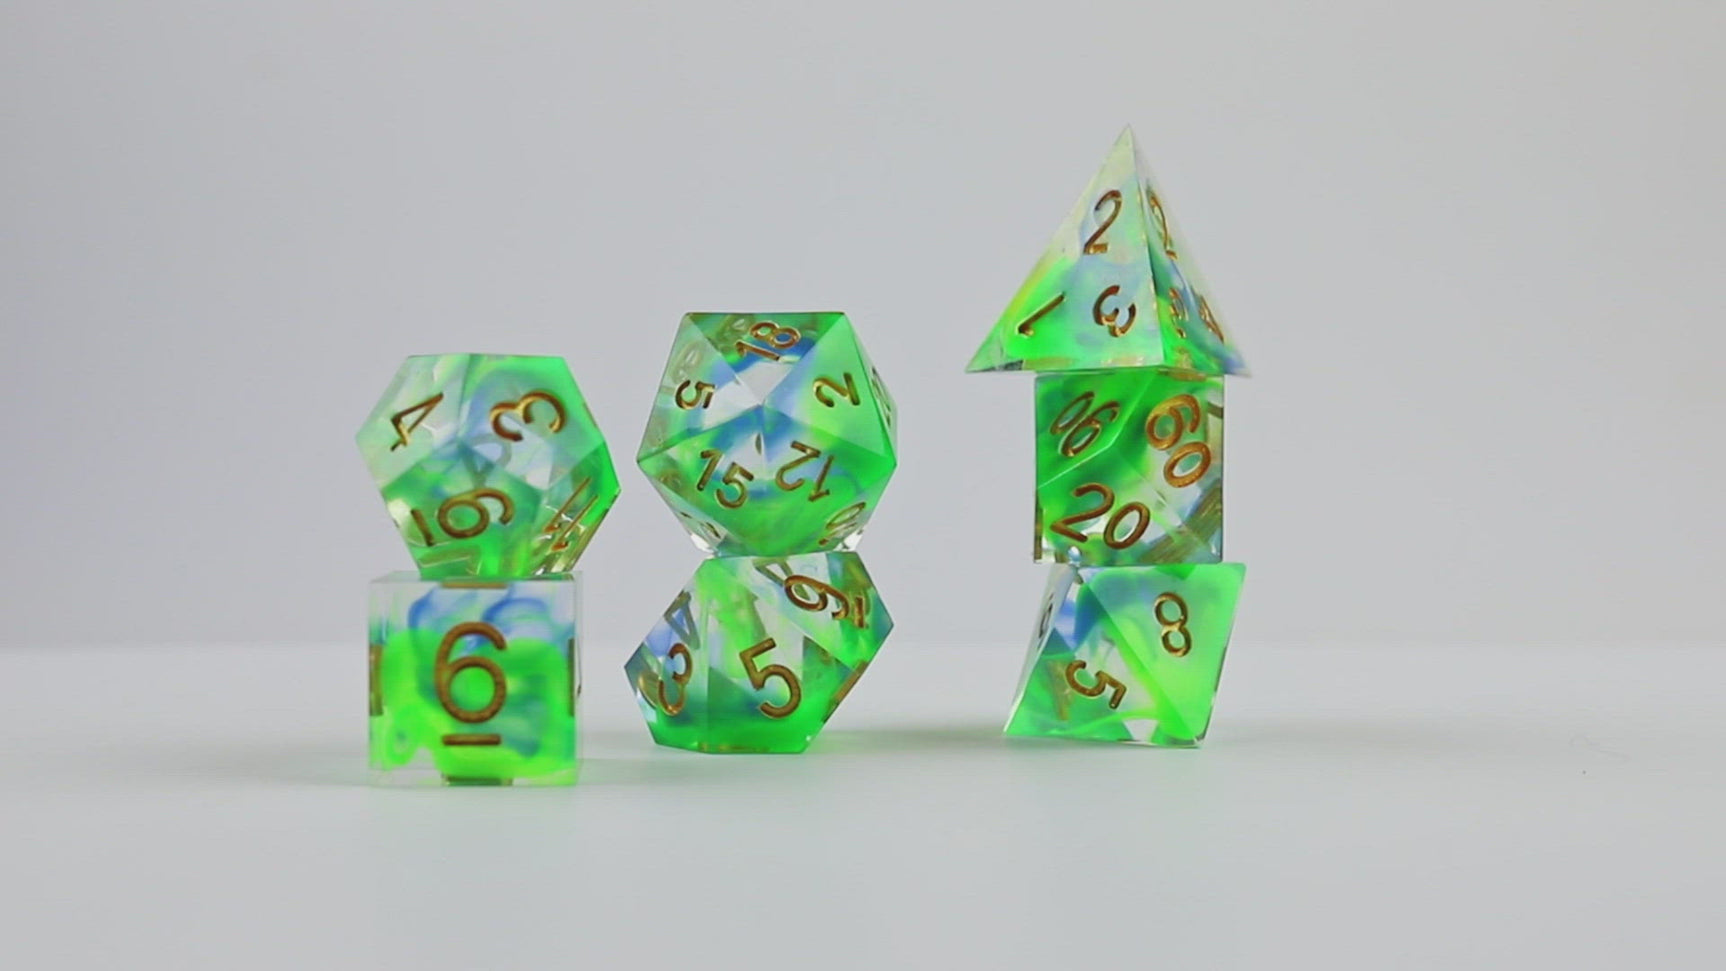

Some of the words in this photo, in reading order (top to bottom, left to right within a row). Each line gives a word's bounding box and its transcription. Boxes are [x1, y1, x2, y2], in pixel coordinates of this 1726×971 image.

[1084, 190, 1122, 255] 2
[1018, 292, 1065, 336] 1
[1093, 285, 1136, 337] 3
[735, 321, 801, 362] 18
[489, 388, 567, 442] 3
[675, 380, 715, 411] 5
[813, 372, 861, 408] 2
[390, 393, 444, 451] 4
[697, 449, 753, 509] 15
[1050, 483, 1151, 550] 20
[1154, 592, 1192, 657] 8
[433, 622, 508, 724] 6
[659, 642, 692, 717] 3
[739, 638, 801, 719] 5
[1066, 660, 1127, 710] 5
